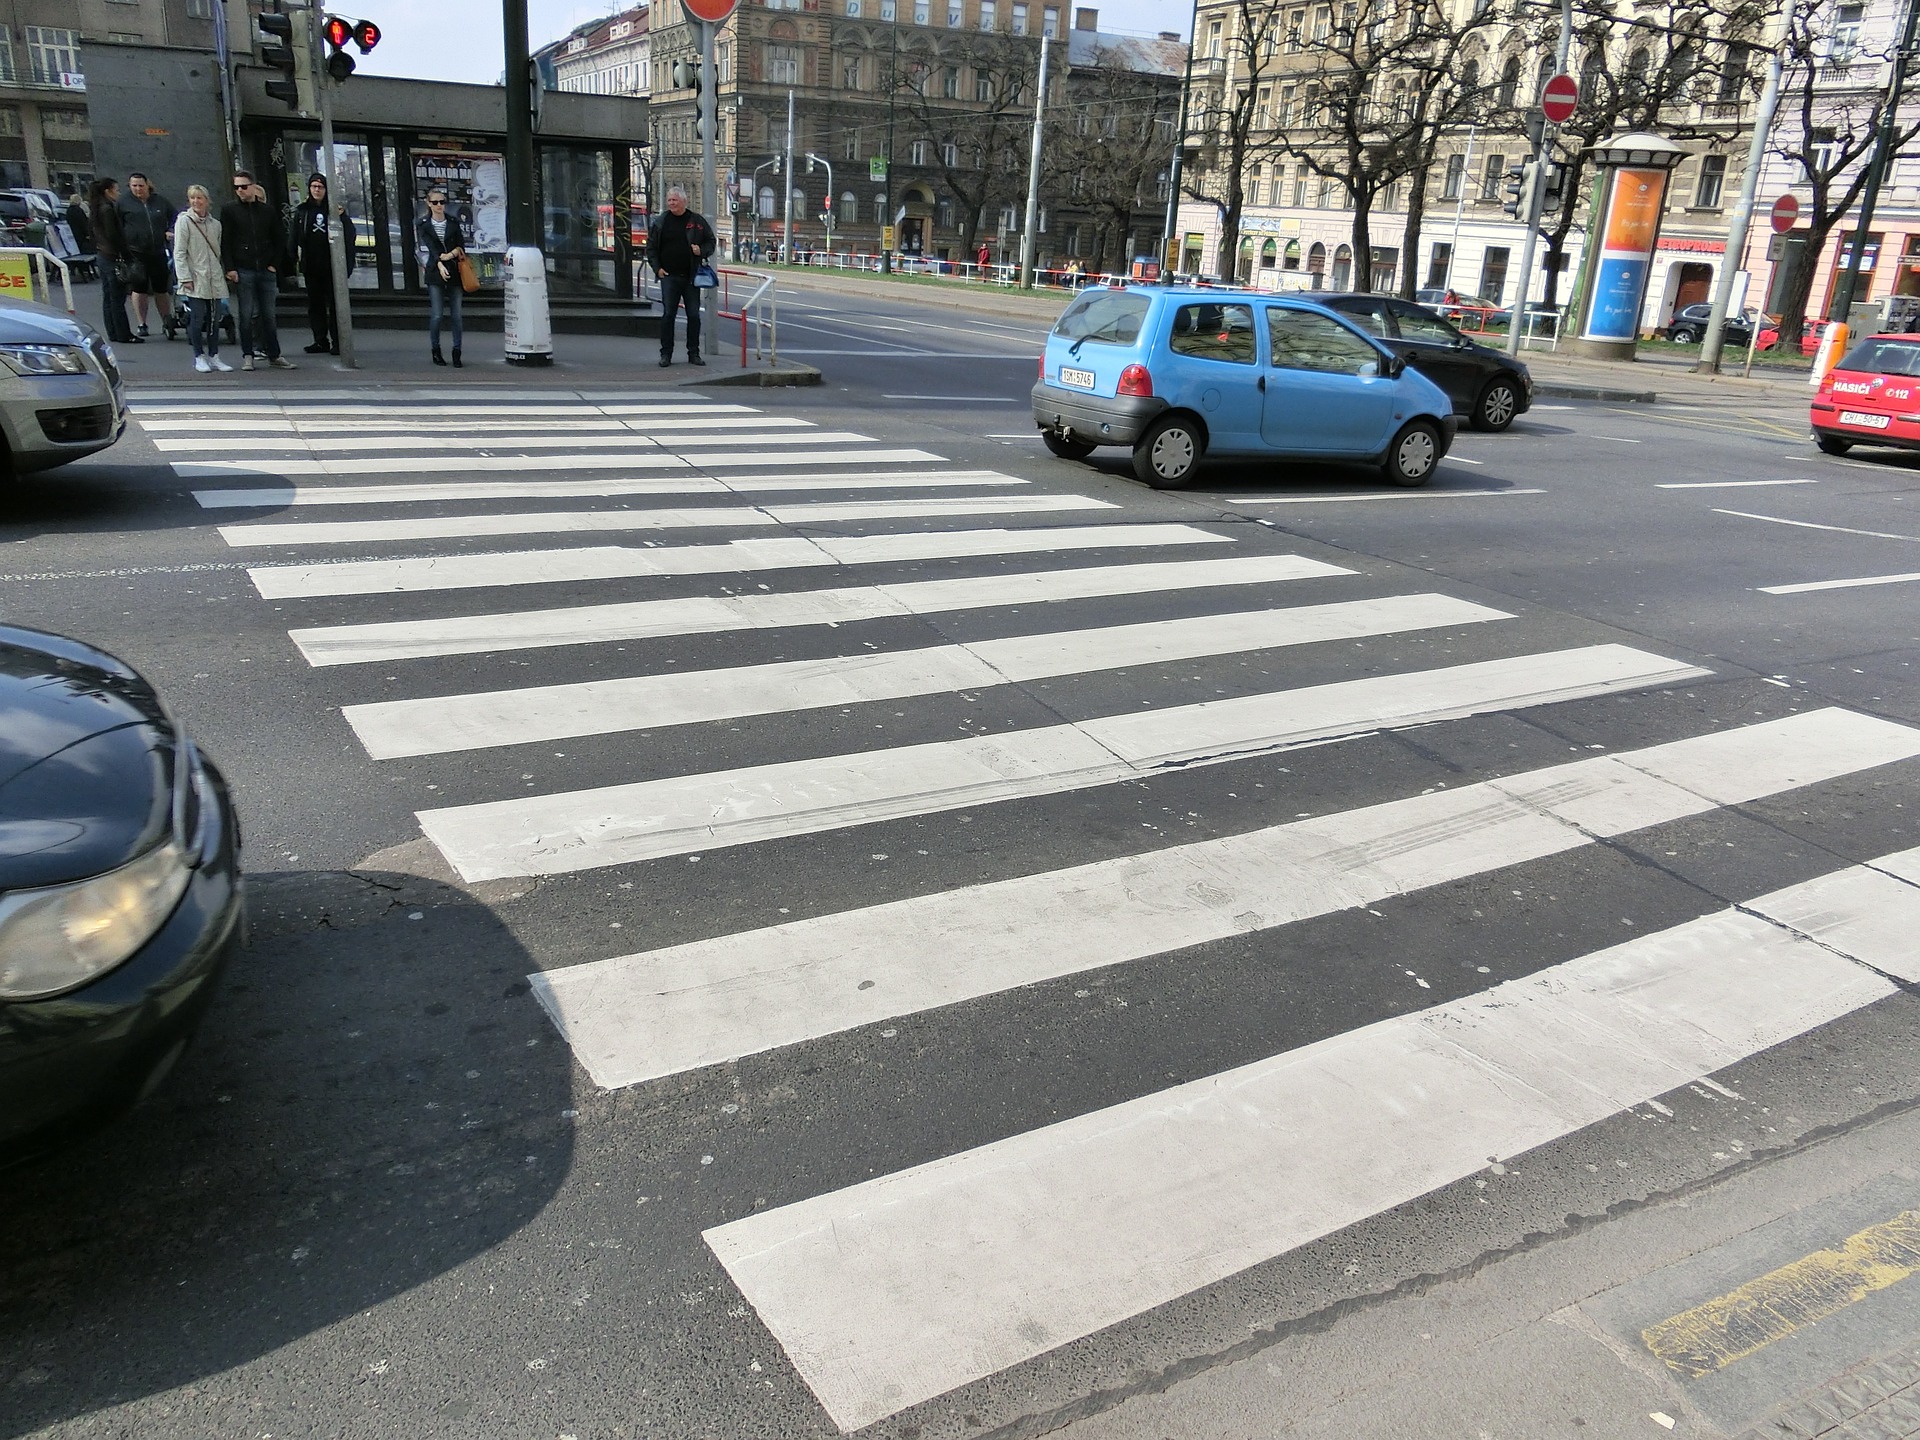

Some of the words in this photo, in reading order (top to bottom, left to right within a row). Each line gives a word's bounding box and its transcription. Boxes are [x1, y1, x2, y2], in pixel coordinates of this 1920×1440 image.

[366, 27, 375, 44] 2
[460, 168, 472, 180] MA
[1833, 381, 1871, 395] HASIČI
[1895, 389, 1910, 400] 112
